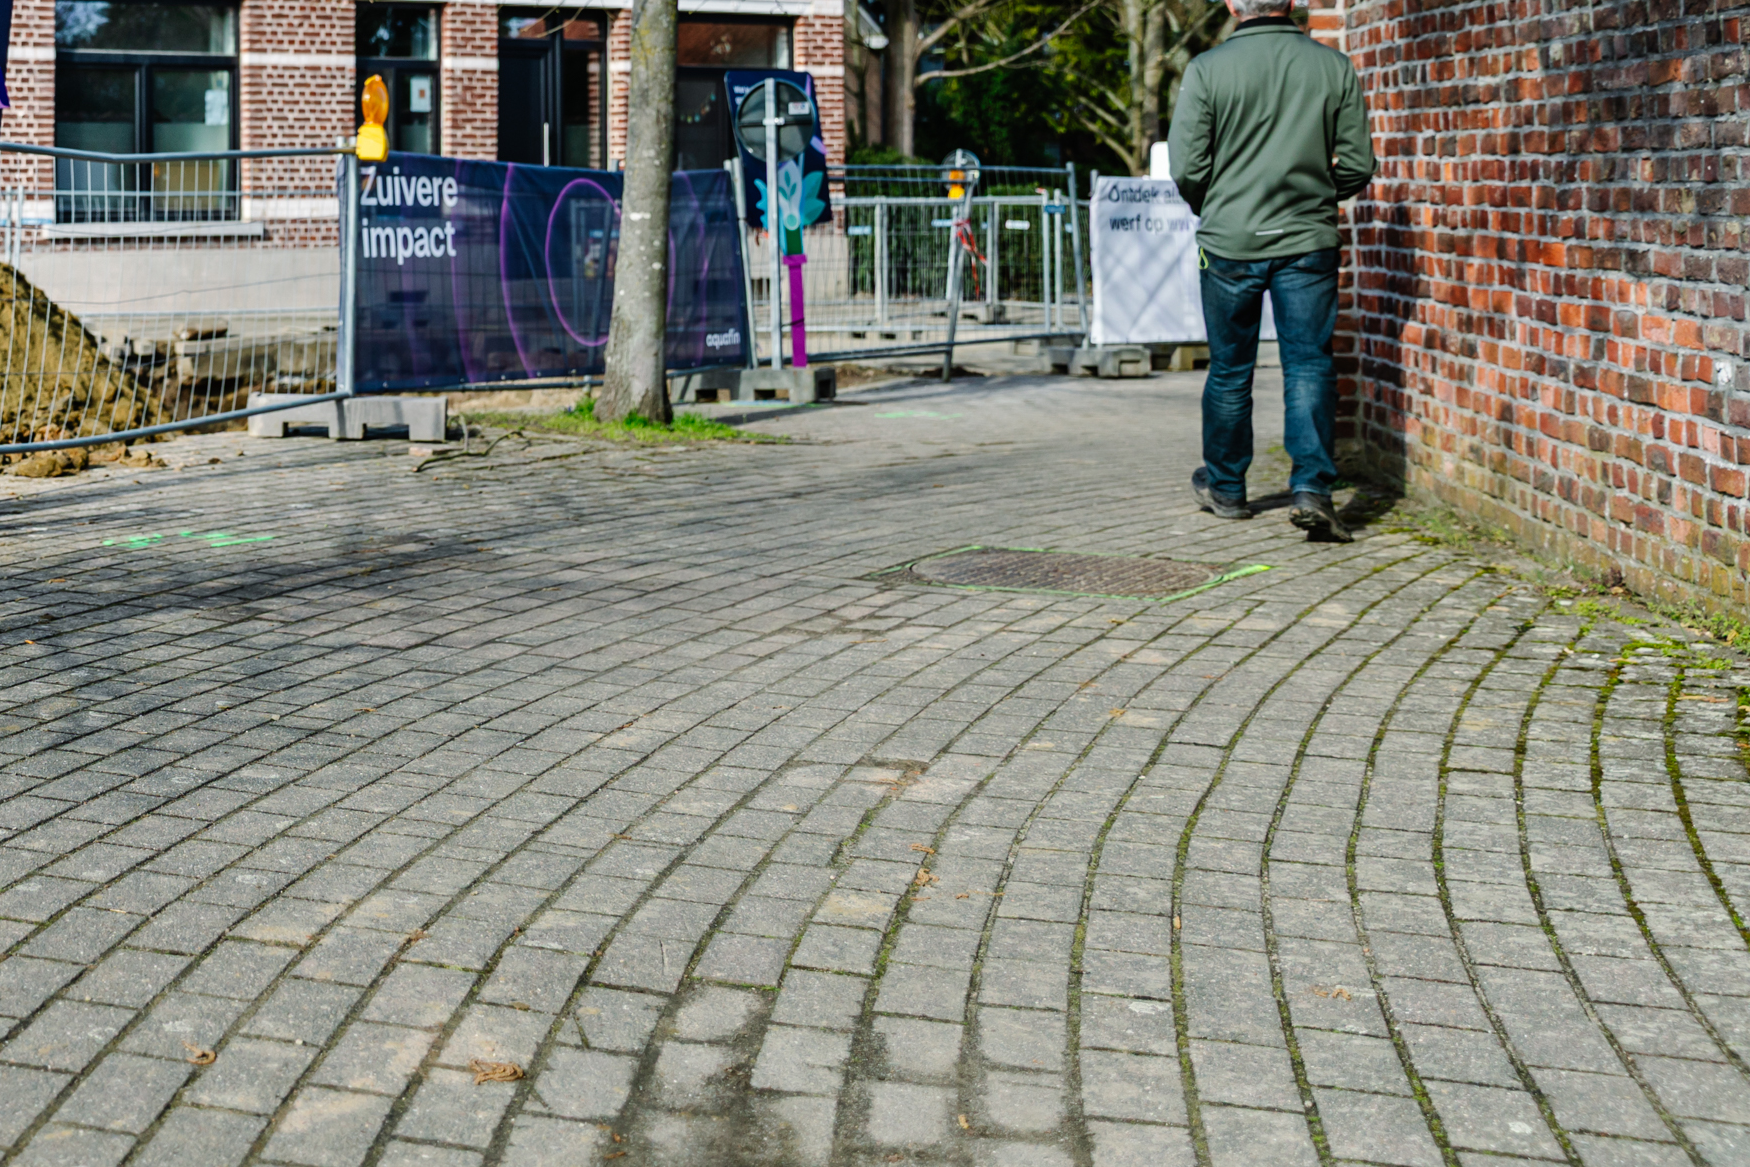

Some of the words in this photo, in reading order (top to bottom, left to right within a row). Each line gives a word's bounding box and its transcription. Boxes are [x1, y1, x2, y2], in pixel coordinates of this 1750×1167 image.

[359, 165, 459, 208] Zuivere
[1108, 184, 1160, 203] Ontdek
[1110, 214, 1141, 232] werf
[1144, 217, 1164, 235] op
[361, 217, 457, 266] impact
[705, 328, 741, 351] aquafin
